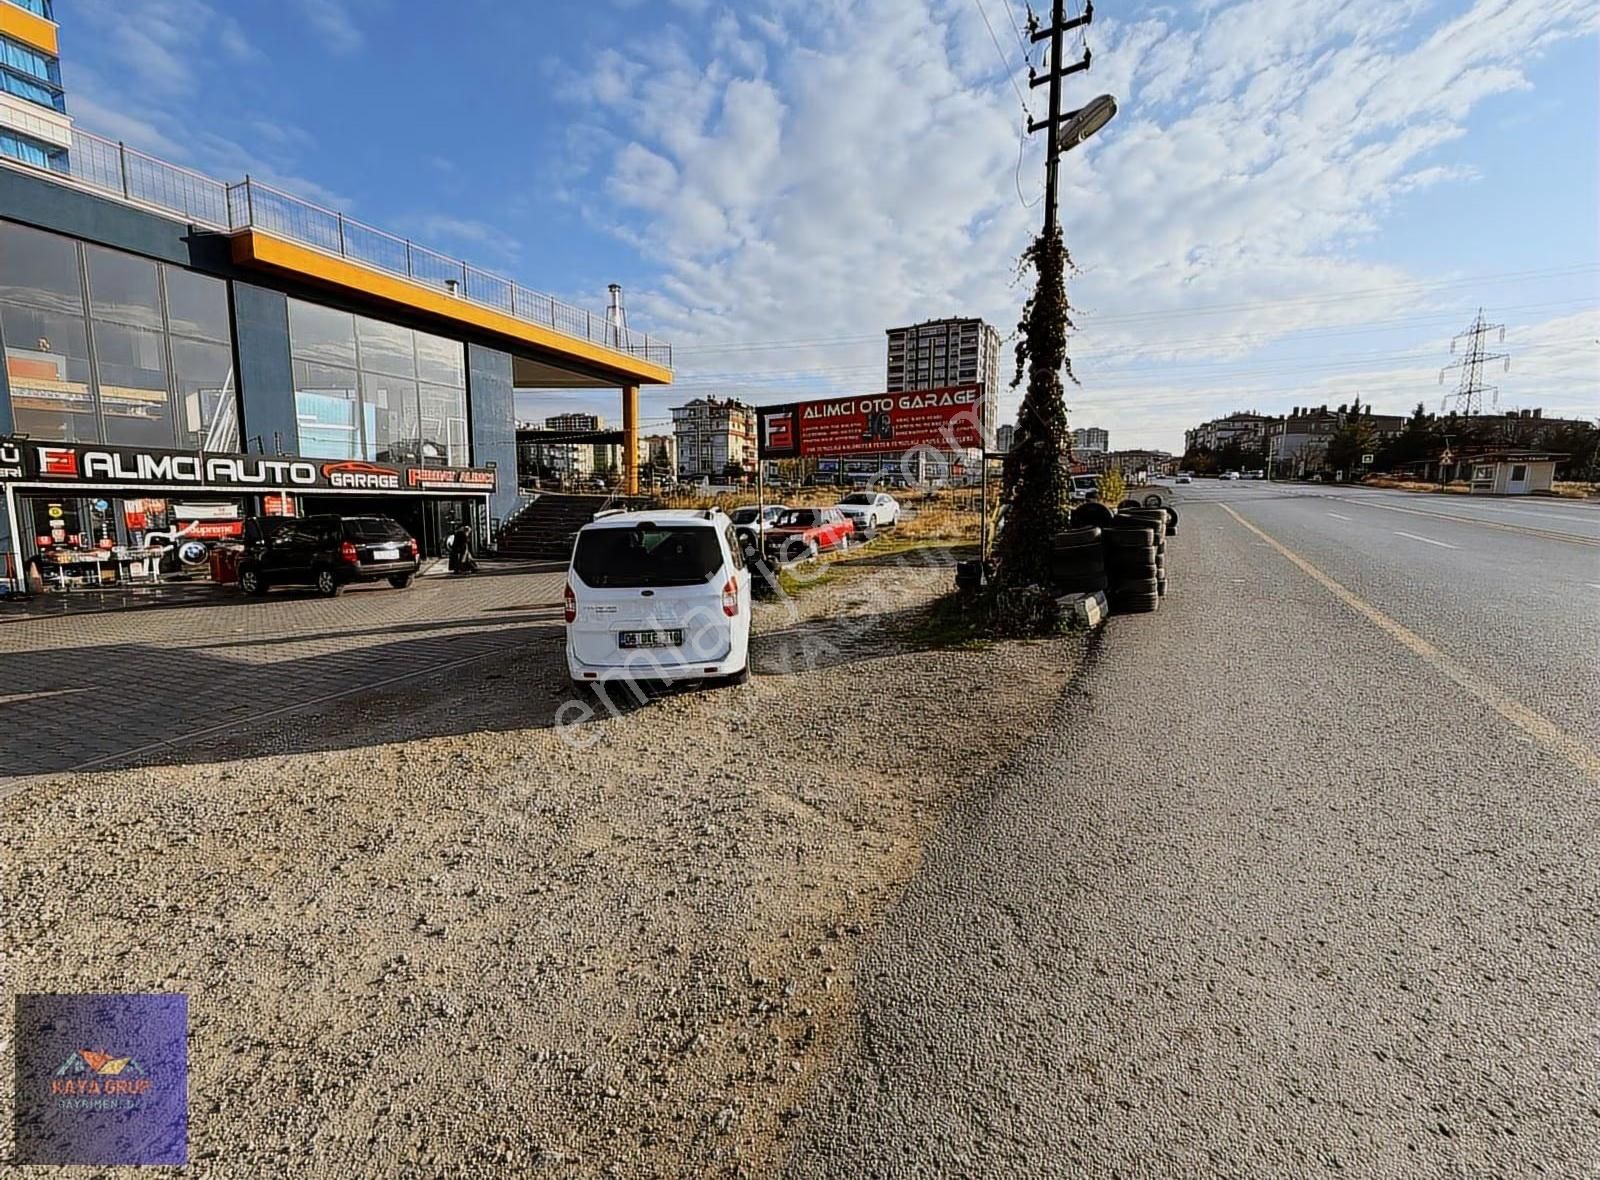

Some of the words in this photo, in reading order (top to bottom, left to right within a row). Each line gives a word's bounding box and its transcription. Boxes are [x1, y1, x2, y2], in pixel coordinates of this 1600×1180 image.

[803, 401, 856, 419] ALIMCI
[860, 398, 895, 414] OTO
[898, 389, 977, 410] GARAGE
[83, 451, 202, 481] ALIMCI
[206, 457, 316, 484] AUTO
[330, 473, 400, 489] GARAGE
